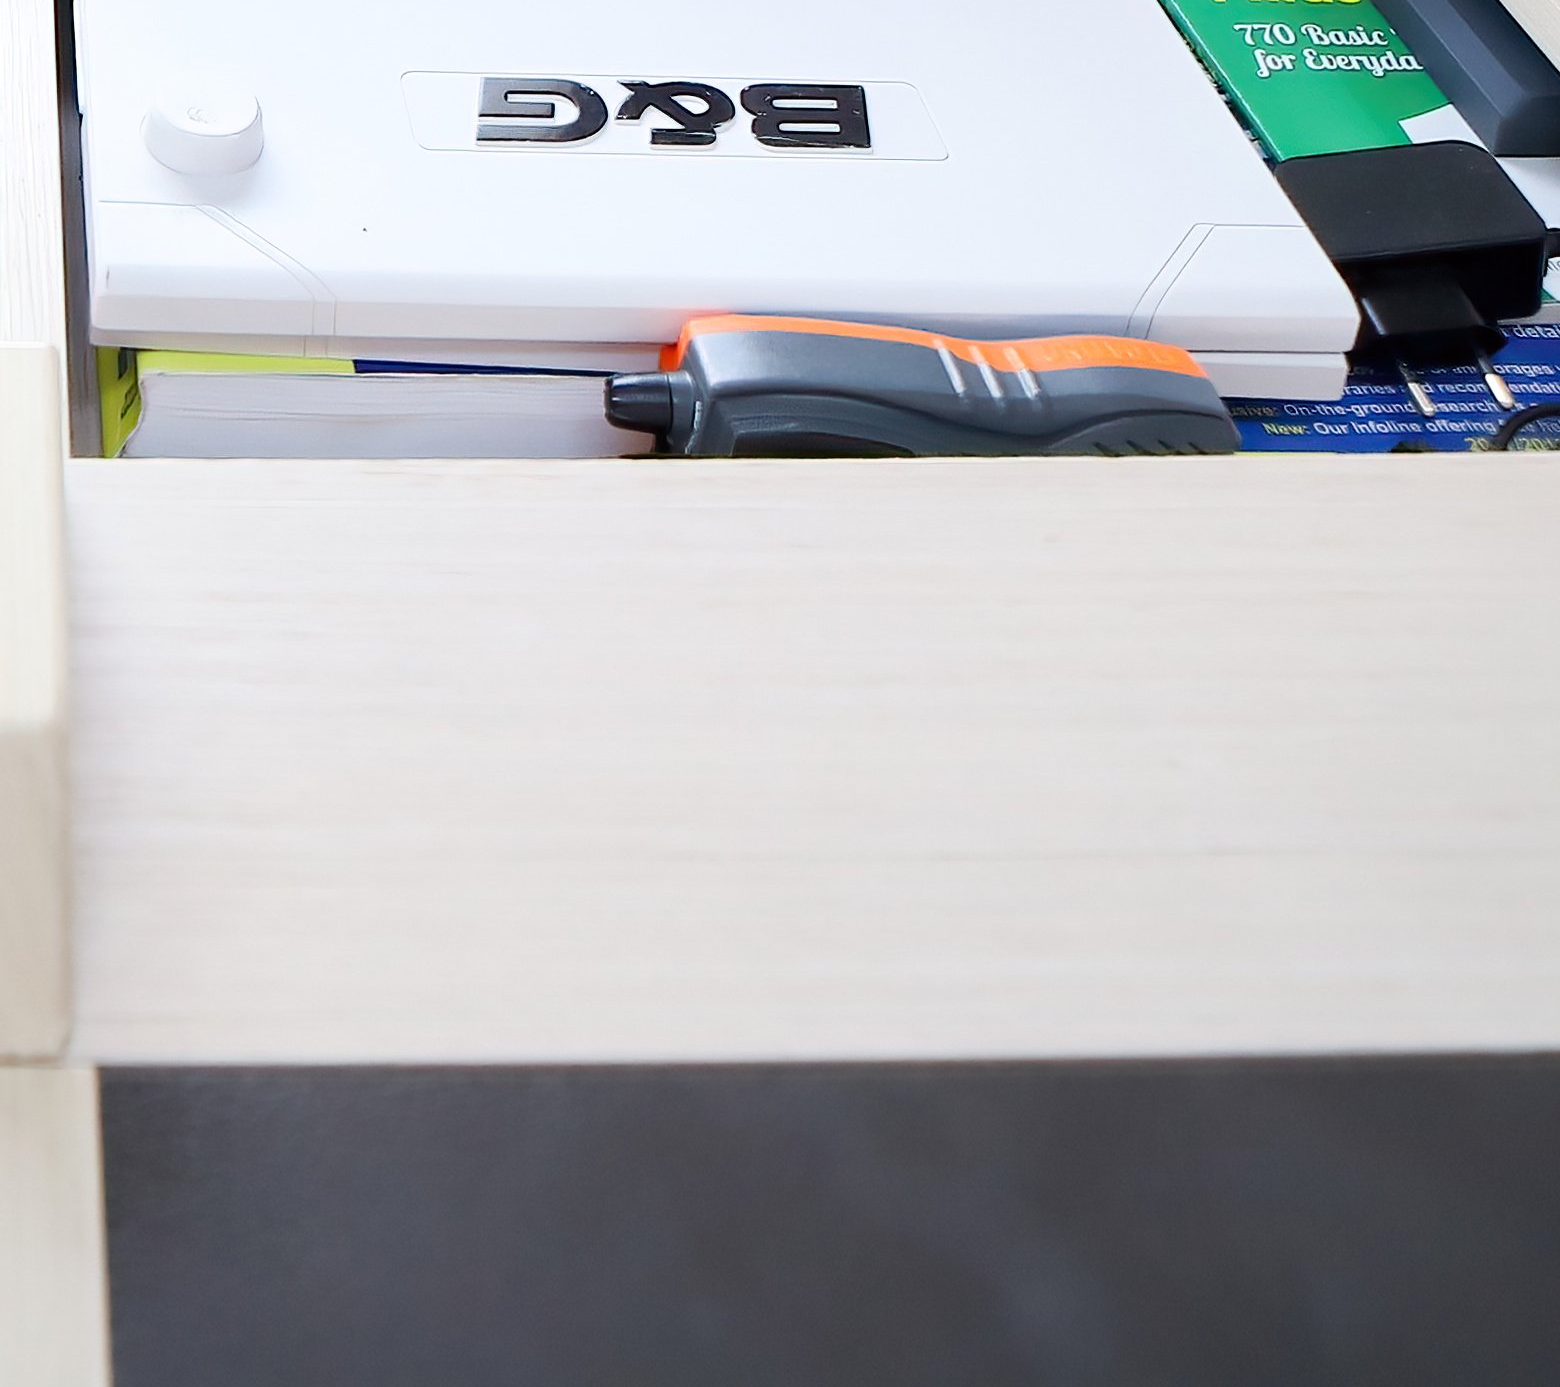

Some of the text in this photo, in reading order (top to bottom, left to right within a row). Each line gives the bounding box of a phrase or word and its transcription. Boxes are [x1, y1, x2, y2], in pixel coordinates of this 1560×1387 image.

[1233, 23, 1389, 47] 770 Basic
[1255, 49, 1425, 79] for Everyda
[476, 76, 874, 153] B&G
[1312, 422, 1346, 435] Our
[1349, 420, 1422, 435] Infoline
[1425, 420, 1497, 435] offering
